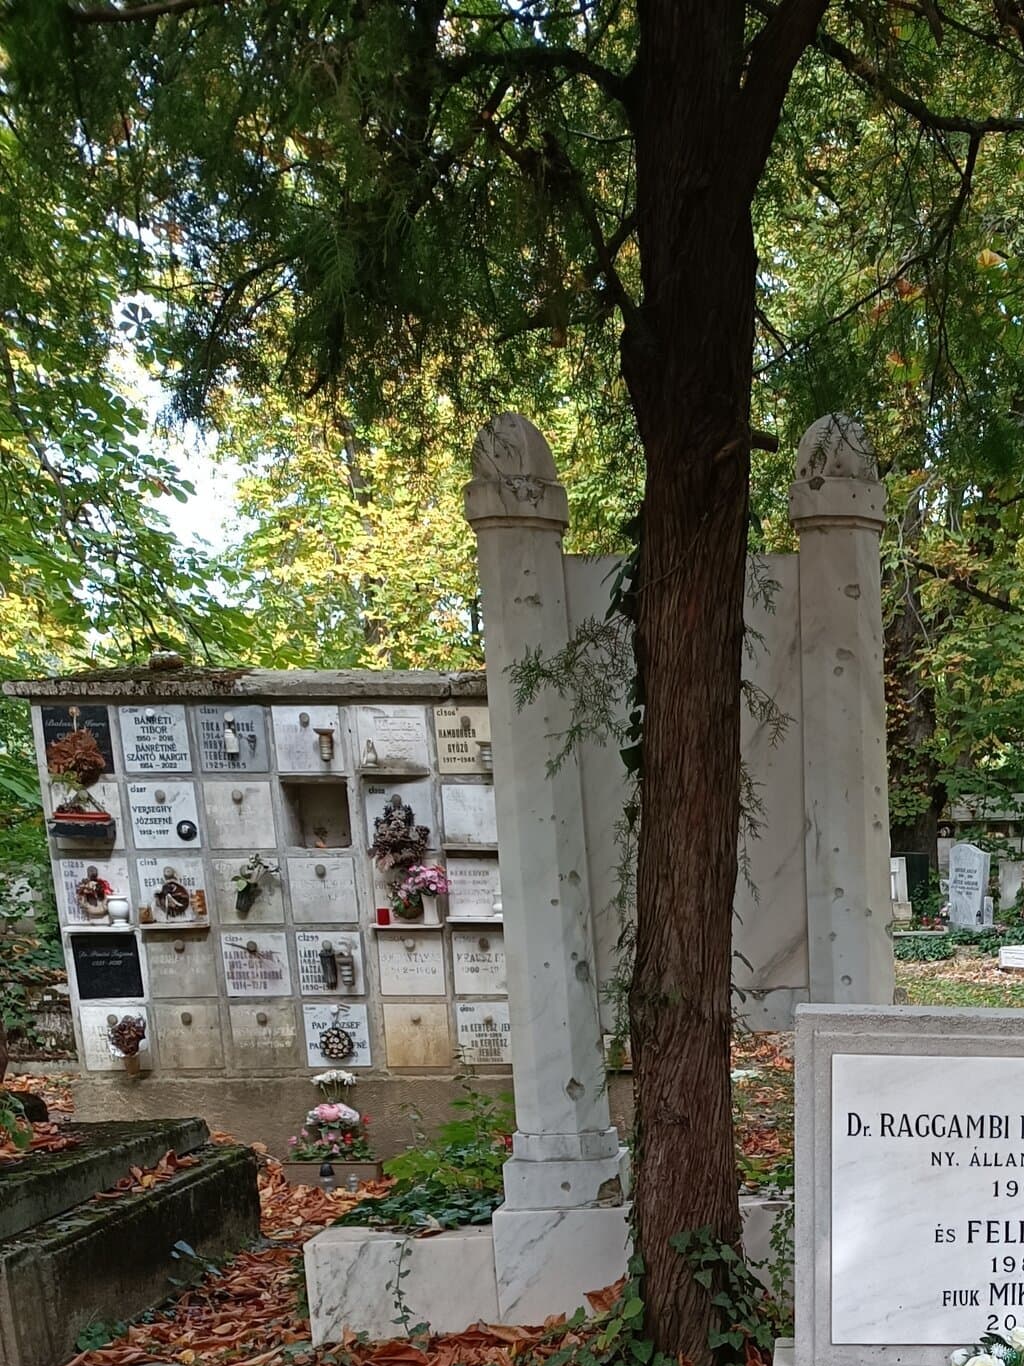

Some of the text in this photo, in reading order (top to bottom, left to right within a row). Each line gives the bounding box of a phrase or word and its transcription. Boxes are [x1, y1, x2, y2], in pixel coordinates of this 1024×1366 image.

[140, 725, 167, 734] TIBOR
[438, 728, 477, 738] HAMBURGER
[158, 752, 188, 761] MARGIT
[131, 805, 173, 813] VERSEGHY
[134, 815, 173, 825] JÓZSEFNÉ
[311, 1022, 328, 1030] PAP
[847, 1112, 872, 1137] Dr.
[880, 1112, 1010, 1139] RAGGAMBI
[931, 1151, 960, 1167] NY.
[942, 1290, 980, 1307] FIUK
